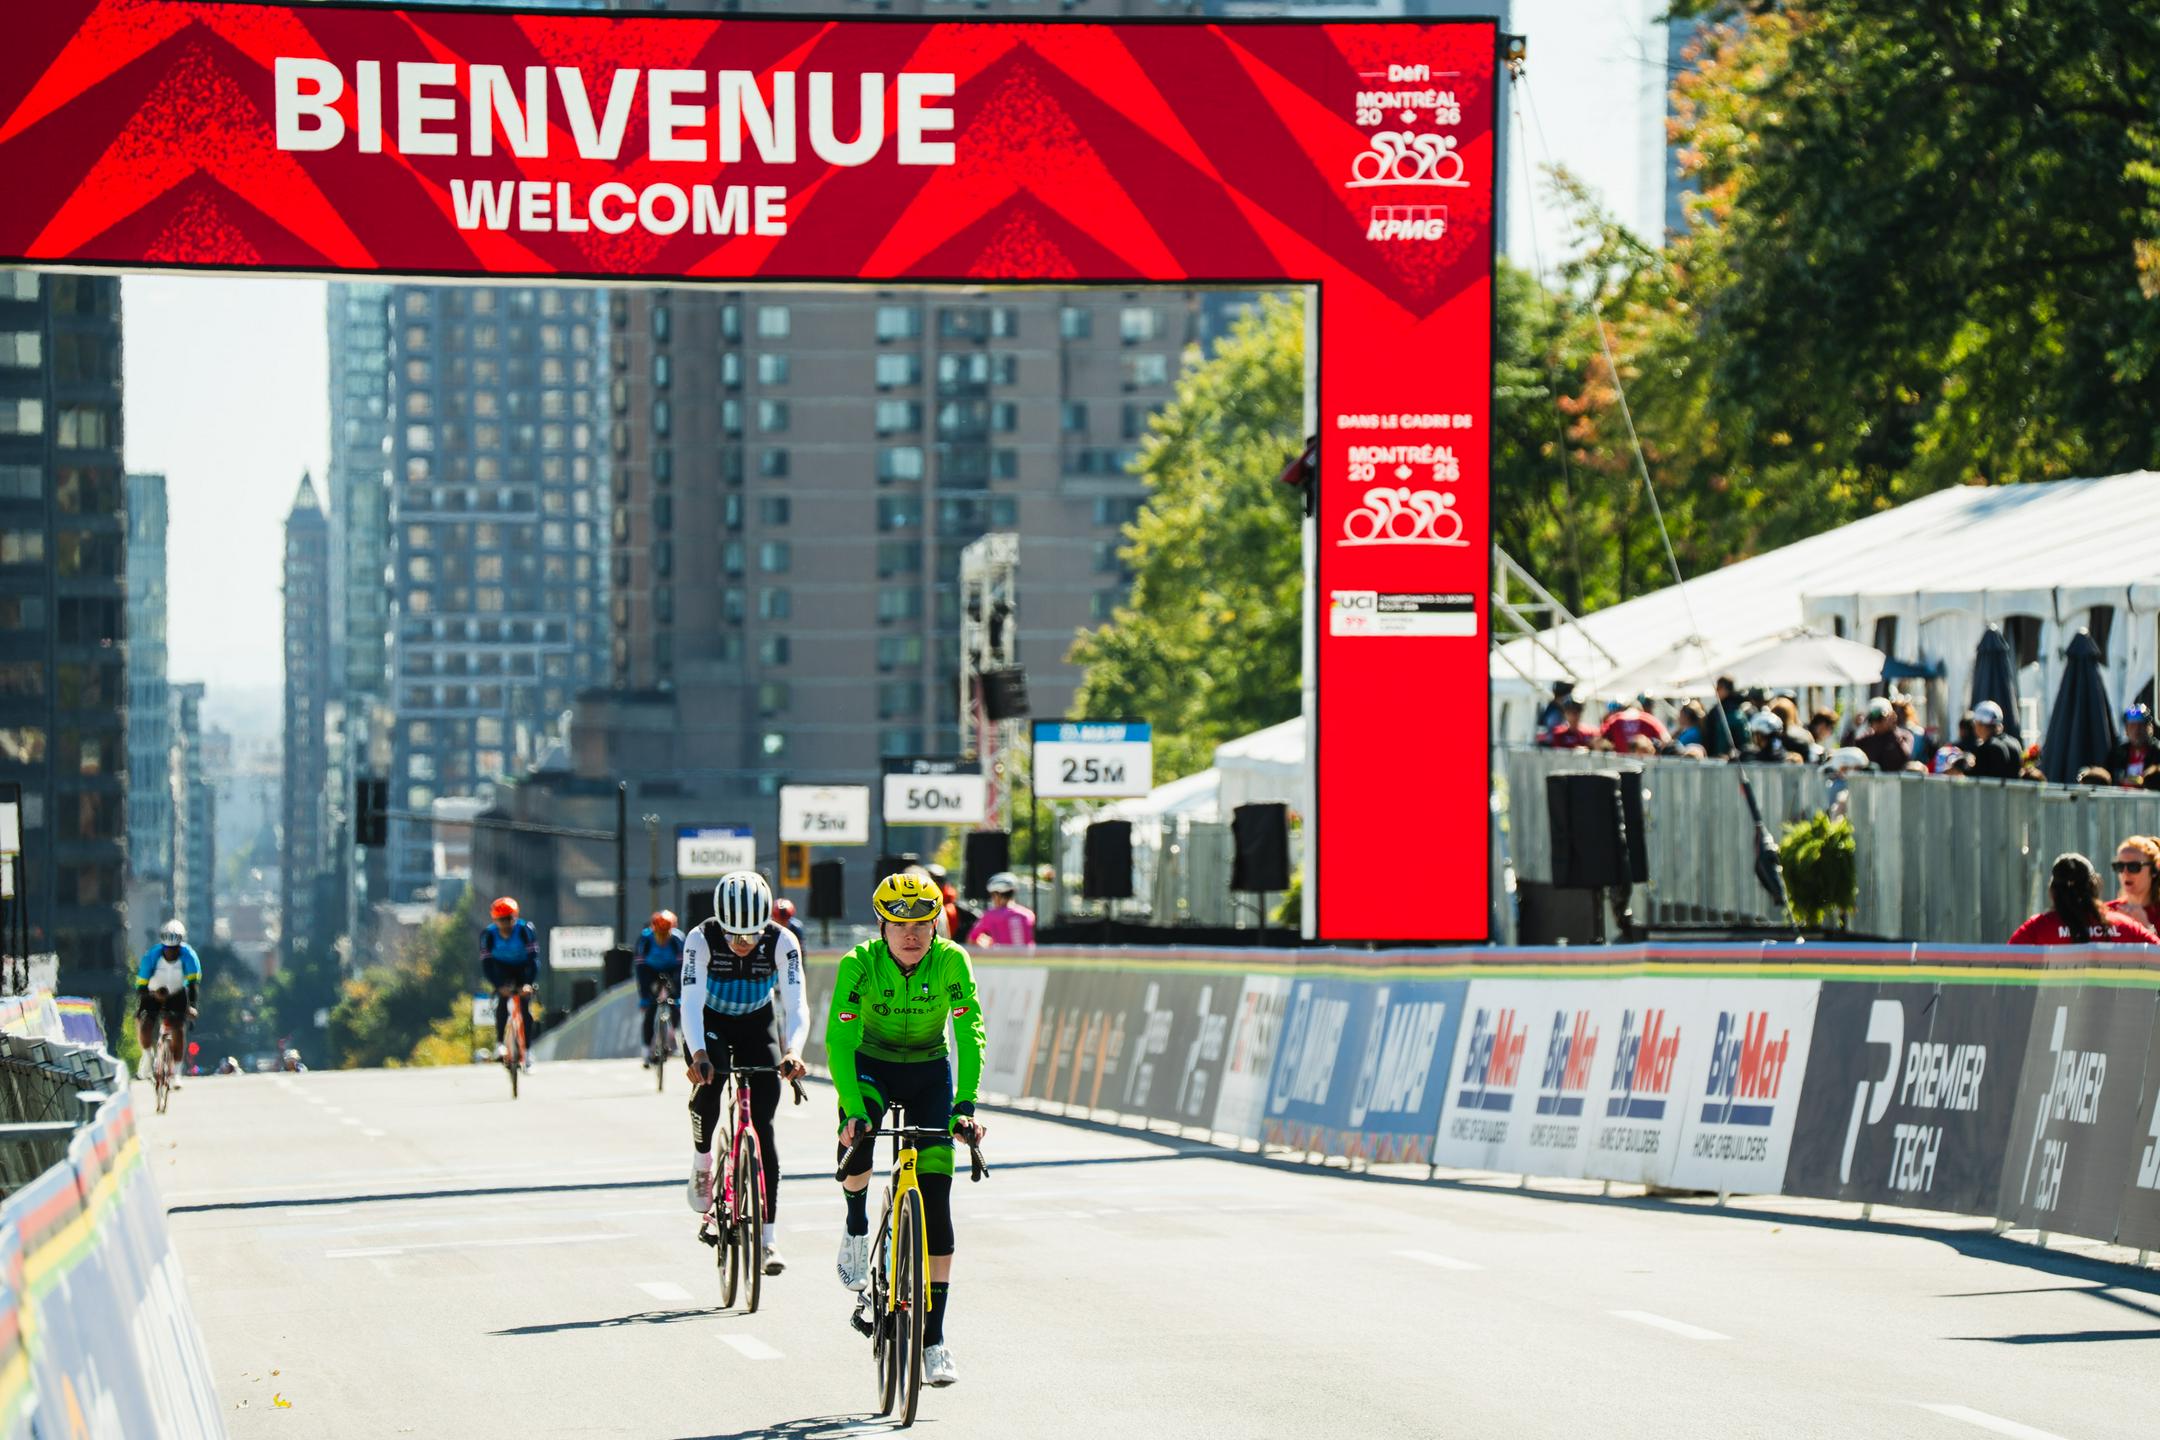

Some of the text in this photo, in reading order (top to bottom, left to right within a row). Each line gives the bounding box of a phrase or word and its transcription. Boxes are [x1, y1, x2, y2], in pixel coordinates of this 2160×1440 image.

[1388, 64, 1430, 82] Défi
[1356, 88, 1460, 109] MONTRÉAL
[275, 57, 956, 165] BIENVENUE
[1356, 107, 1461, 126] 20 26
[449, 178, 788, 236] WELCOME
[1366, 218, 1446, 241] KPMG
[1337, 413, 1473, 429] DANS LE CADRE DE
[1348, 443, 1459, 464] MONTRÉAL
[1347, 463, 1461, 482] 20 26
[1341, 596, 1372, 609] UCI
[2058, 925, 2122, 938] MICAL
[1611, 1009, 1681, 1118] BigMat
[1706, 1012, 1789, 1122] BigMat
[1900, 1041, 1986, 1112] PREMIER
[1888, 1124, 1943, 1192] TECH
